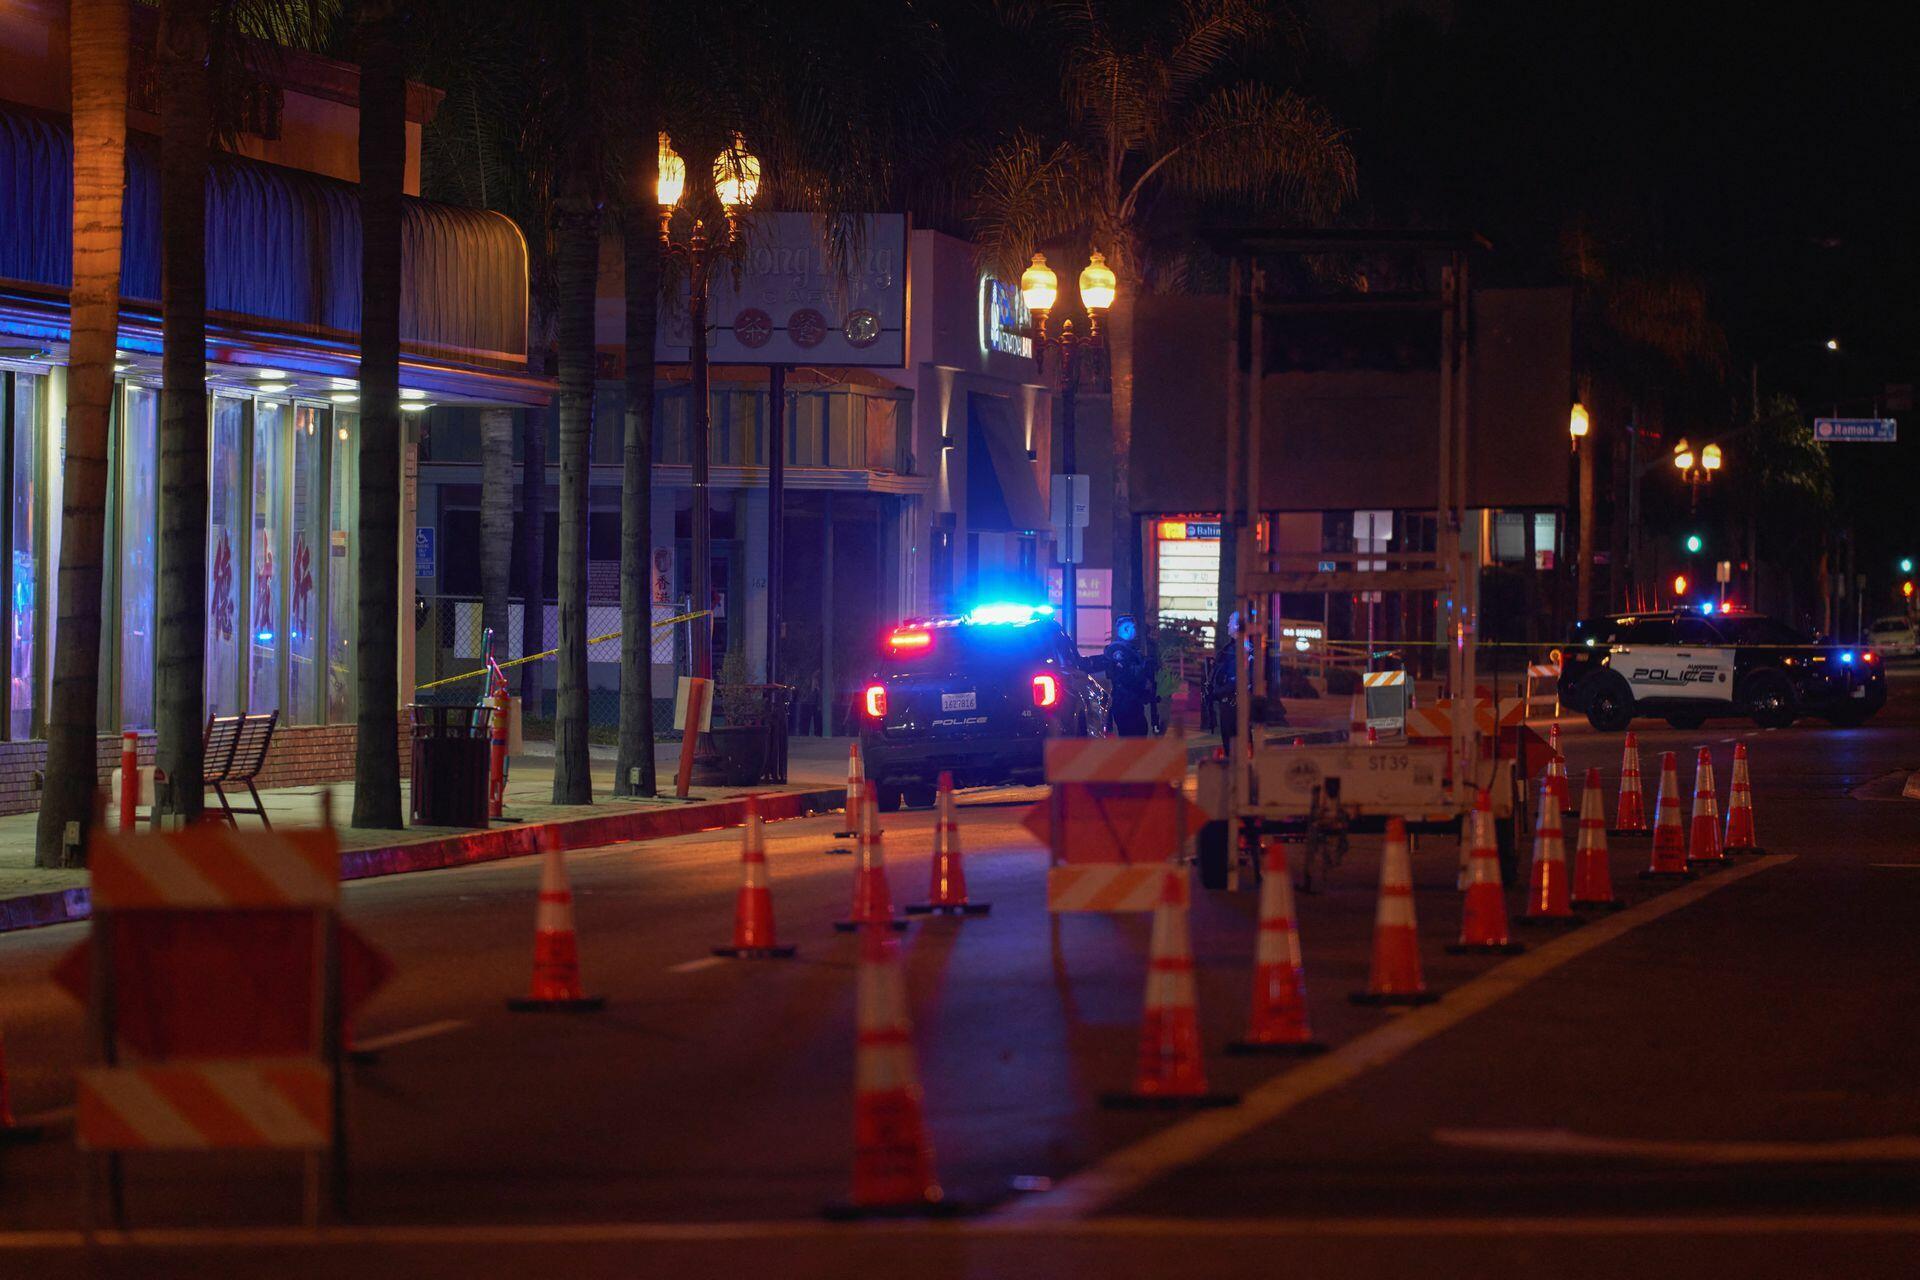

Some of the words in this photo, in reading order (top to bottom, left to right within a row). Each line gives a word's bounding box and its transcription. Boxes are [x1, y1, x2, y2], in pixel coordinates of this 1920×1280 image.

[1834, 424, 1874, 436] Ramona
[1633, 668, 1715, 682] POLICE
[932, 717, 988, 727] POLICE
